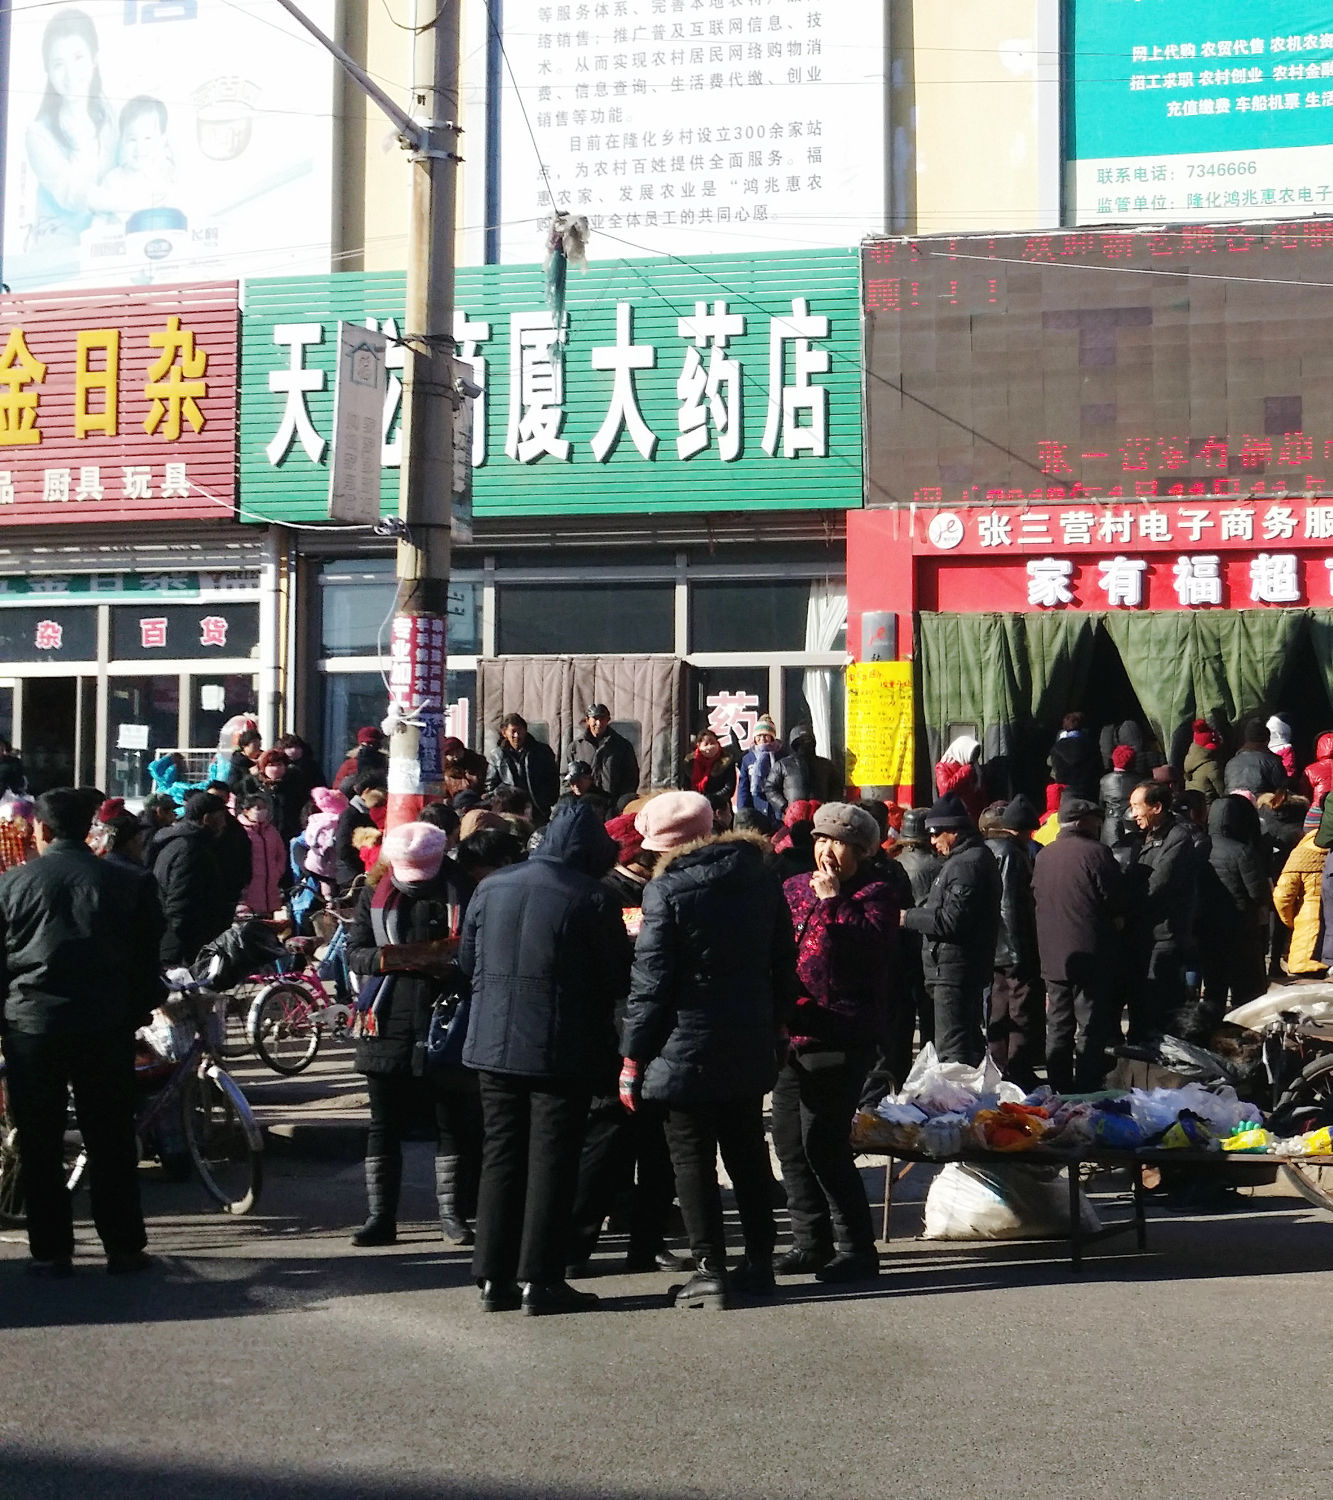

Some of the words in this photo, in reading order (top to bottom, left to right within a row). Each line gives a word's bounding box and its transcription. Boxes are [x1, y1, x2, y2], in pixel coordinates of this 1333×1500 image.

[537, 0, 823, 24] 等服务体系、完善本地
[538, 39, 823, 76] 术。从而实现农村居民网络购物消
[1132, 43, 1196, 63] 网上代购
[1201, 37, 1265, 58] 农贸代售
[538, 66, 823, 103] 费、信息查询、生活费代缴、创业
[1130, 71, 1194, 91] 招工求职
[1198, 67, 1264, 87] 农村创业
[537, 107, 635, 128] 销售等功能。
[1166, 99, 1231, 118] 充值缴费
[1235, 93, 1301, 112] 车船机票
[569, 119, 823, 152] 目前在隆化乡村设立300余家站
[536, 204, 779, 233] 购业全体员工的共同心愿。
[266, 296, 831, 467] 天厦大药店
[43, 466, 105, 503] 厨具
[122, 462, 190, 500] 玩具
[35, 620, 63, 649] 杂
[140, 616, 228, 648] 百货
[706, 690, 761, 750] 药
